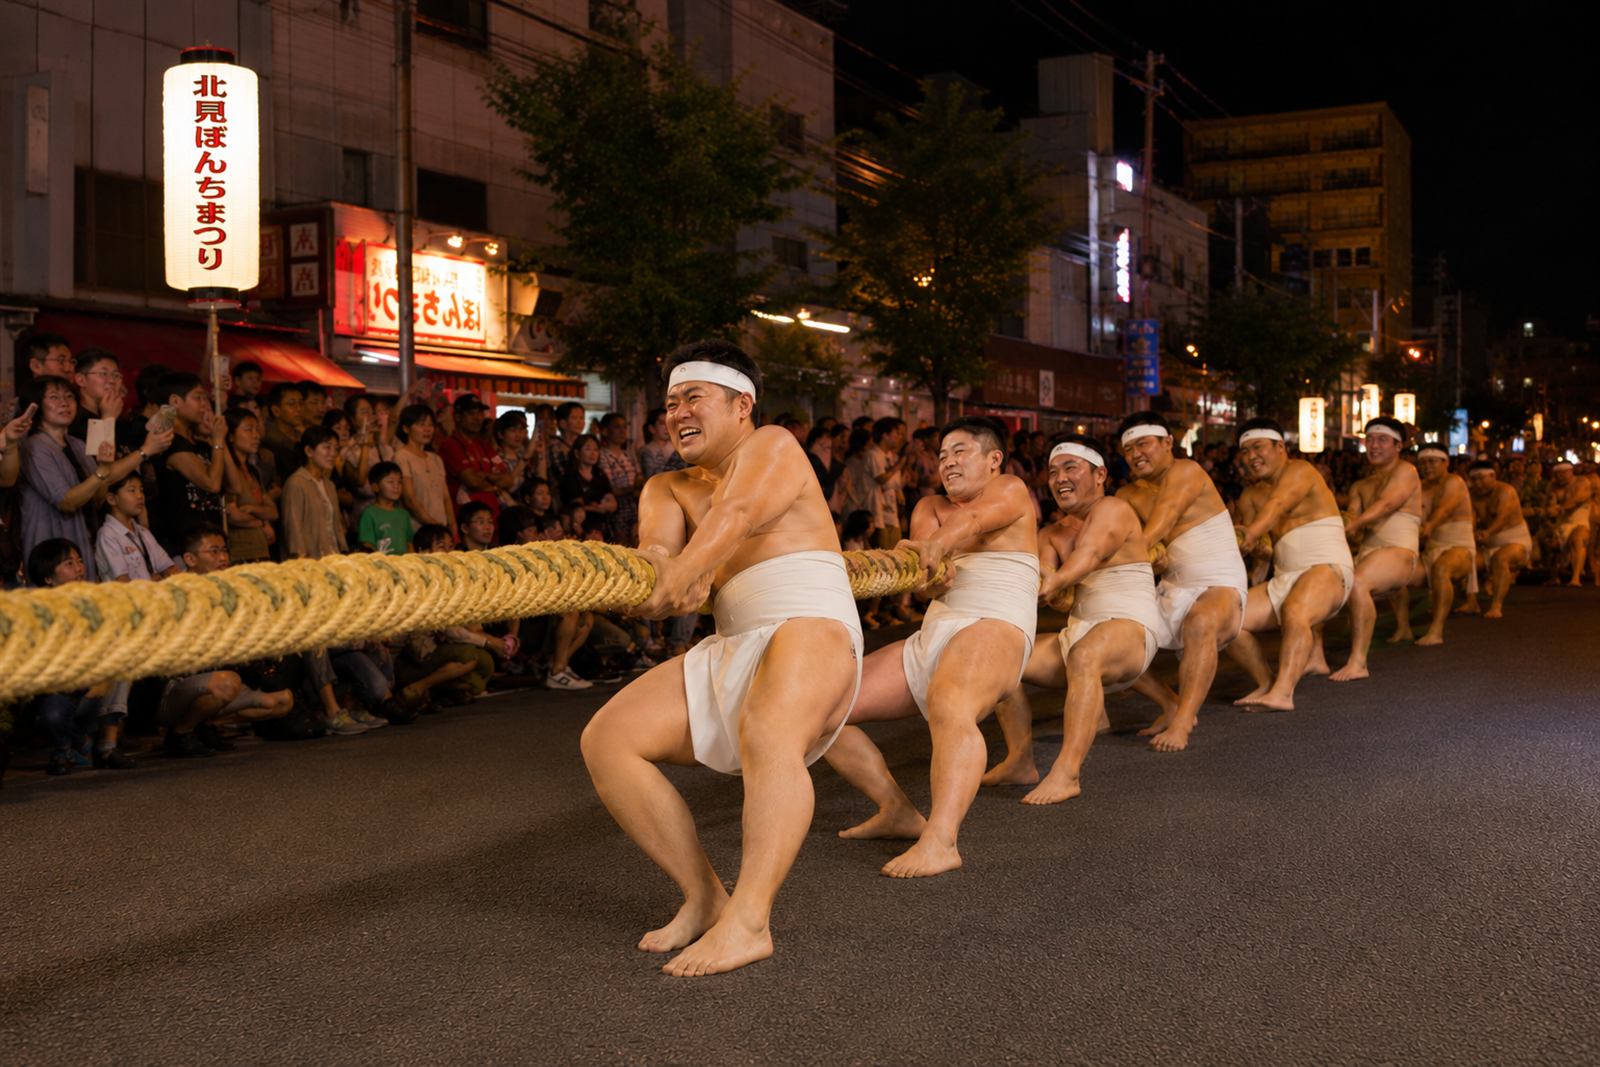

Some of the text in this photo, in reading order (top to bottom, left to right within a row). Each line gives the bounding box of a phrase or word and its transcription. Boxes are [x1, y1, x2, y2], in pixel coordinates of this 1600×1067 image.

[193, 74, 227, 271] 北見ぼんちまつり
